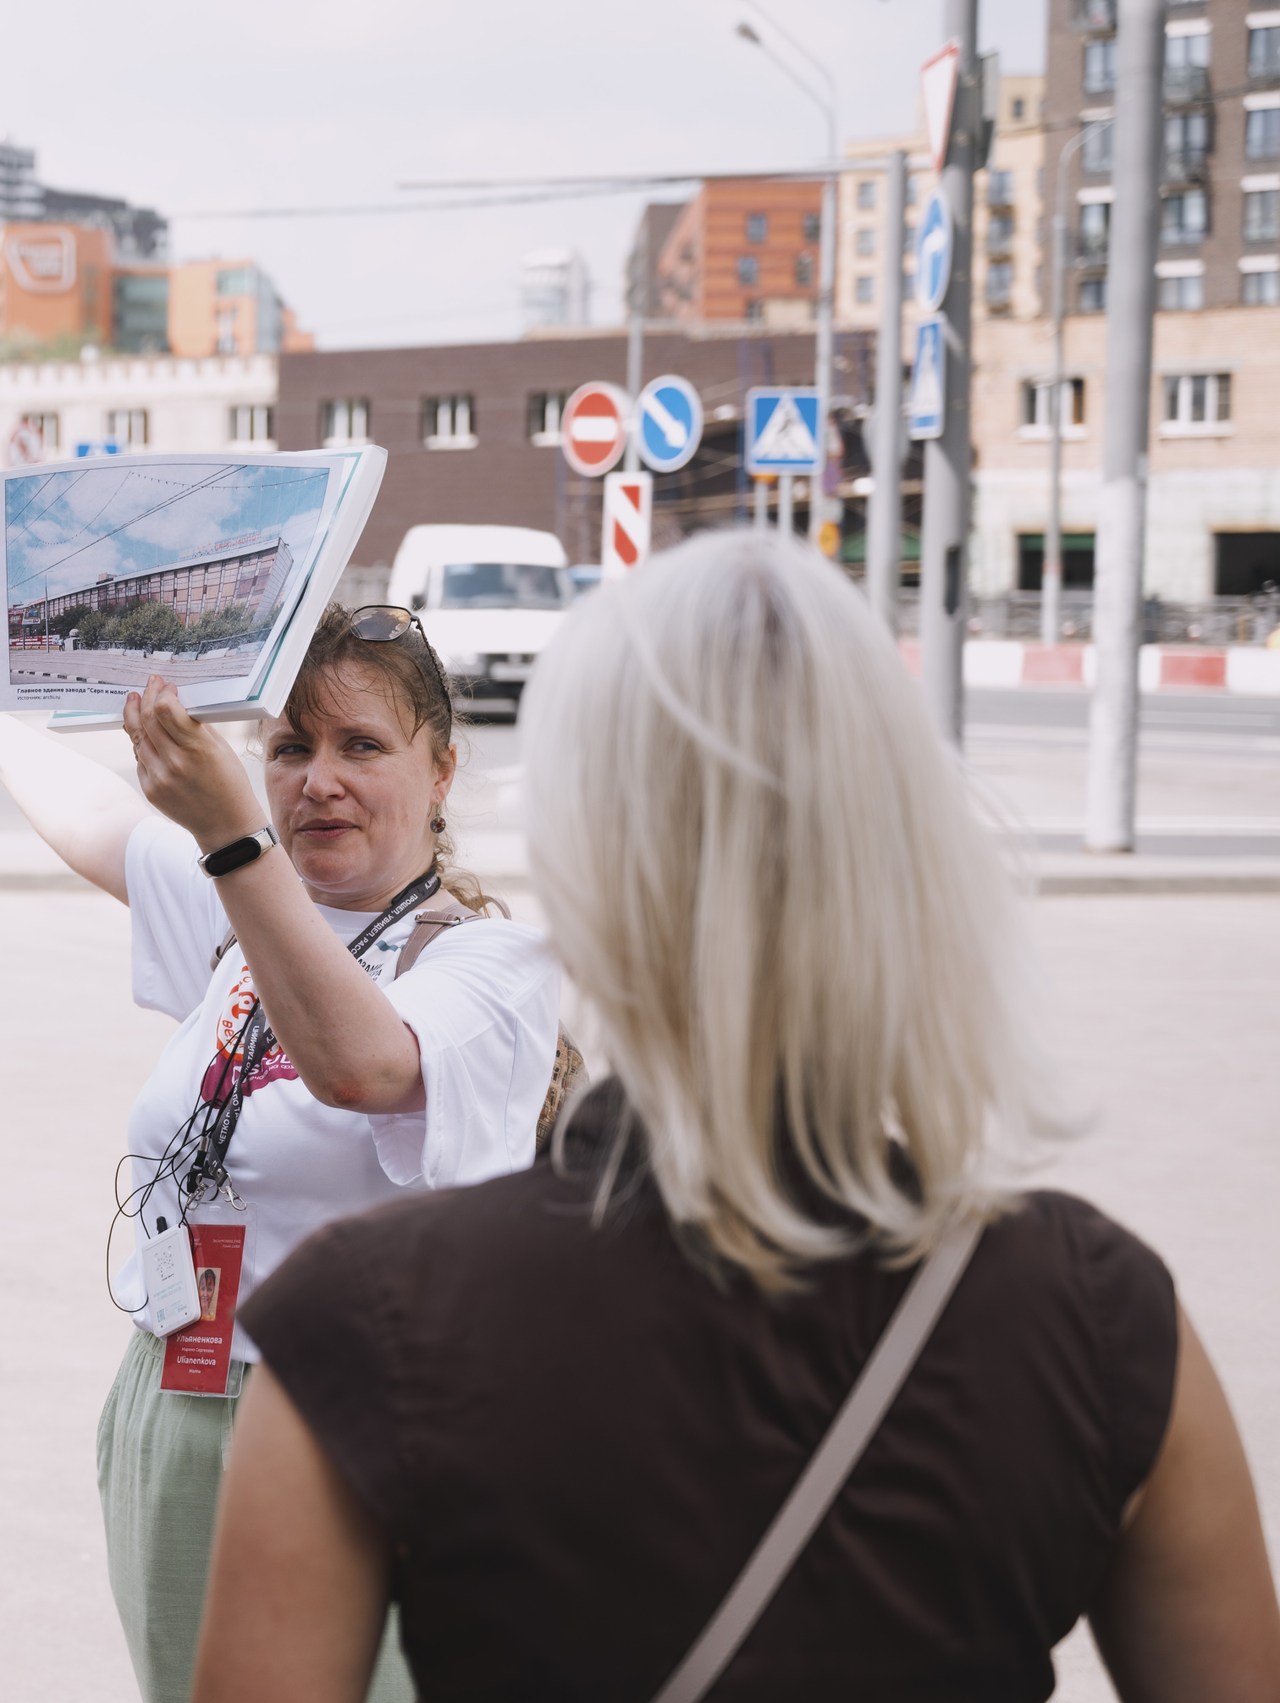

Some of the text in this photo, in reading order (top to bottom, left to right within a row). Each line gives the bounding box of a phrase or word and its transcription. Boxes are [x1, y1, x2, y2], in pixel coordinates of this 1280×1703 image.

[391, 893, 418, 915] ПРОШЕЛ,
[366, 914, 394, 937] УВИДЕЛ,
[218, 1118, 231, 1145] ЧЕТКО
[176, 1334, 222, 1344] Ульяненкова
[177, 1356, 216, 1366] Ulianenkova
